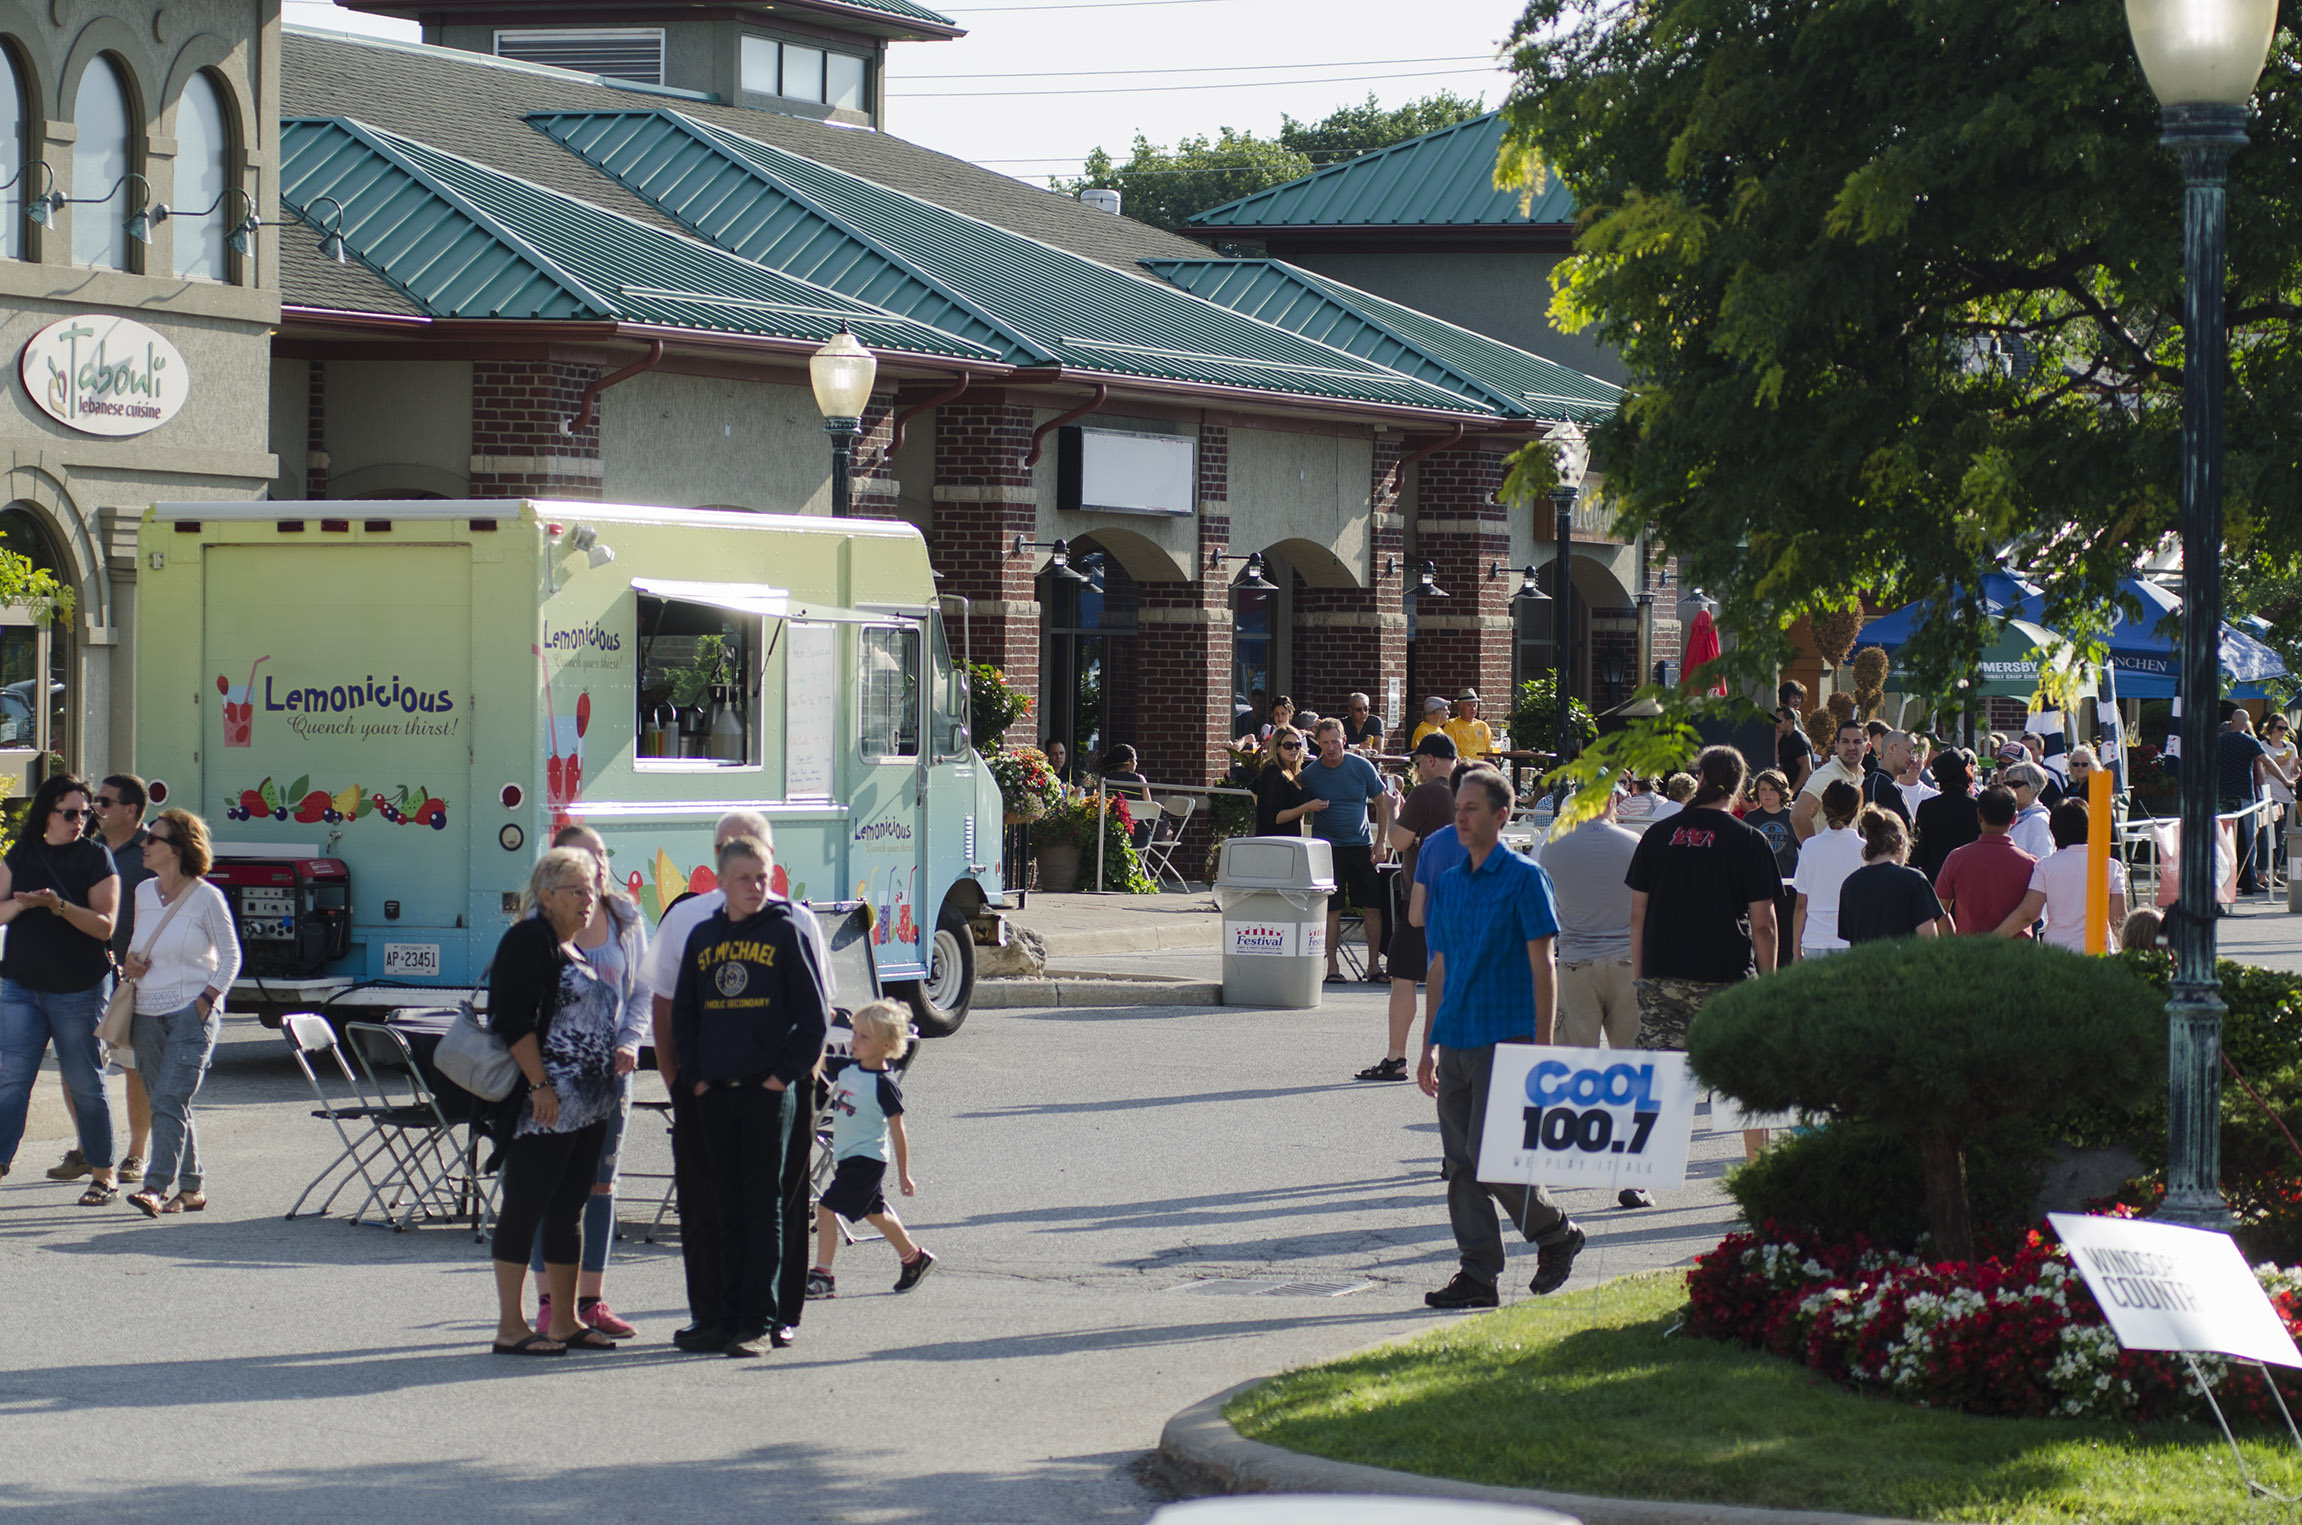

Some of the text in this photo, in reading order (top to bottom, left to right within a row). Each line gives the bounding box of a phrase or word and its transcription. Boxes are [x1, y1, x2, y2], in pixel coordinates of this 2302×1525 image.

[60, 321, 167, 419] Tabouli
[79, 395, 162, 419] lebanese cuisine
[543, 619, 621, 651] Lemonicious
[1980, 661, 2039, 673] MERSBY
[264, 675, 454, 713] Lemonicious
[287, 714, 459, 742] Quench your thirst!
[854, 815, 912, 841] Lemonicious
[1236, 935, 1284, 946] Festival
[405, 951, 436, 968] 23451
[1525, 1060, 1662, 1113] COOL
[1522, 1106, 1659, 1154] 100.7
[1545, 1156, 1586, 1171] PLAY
